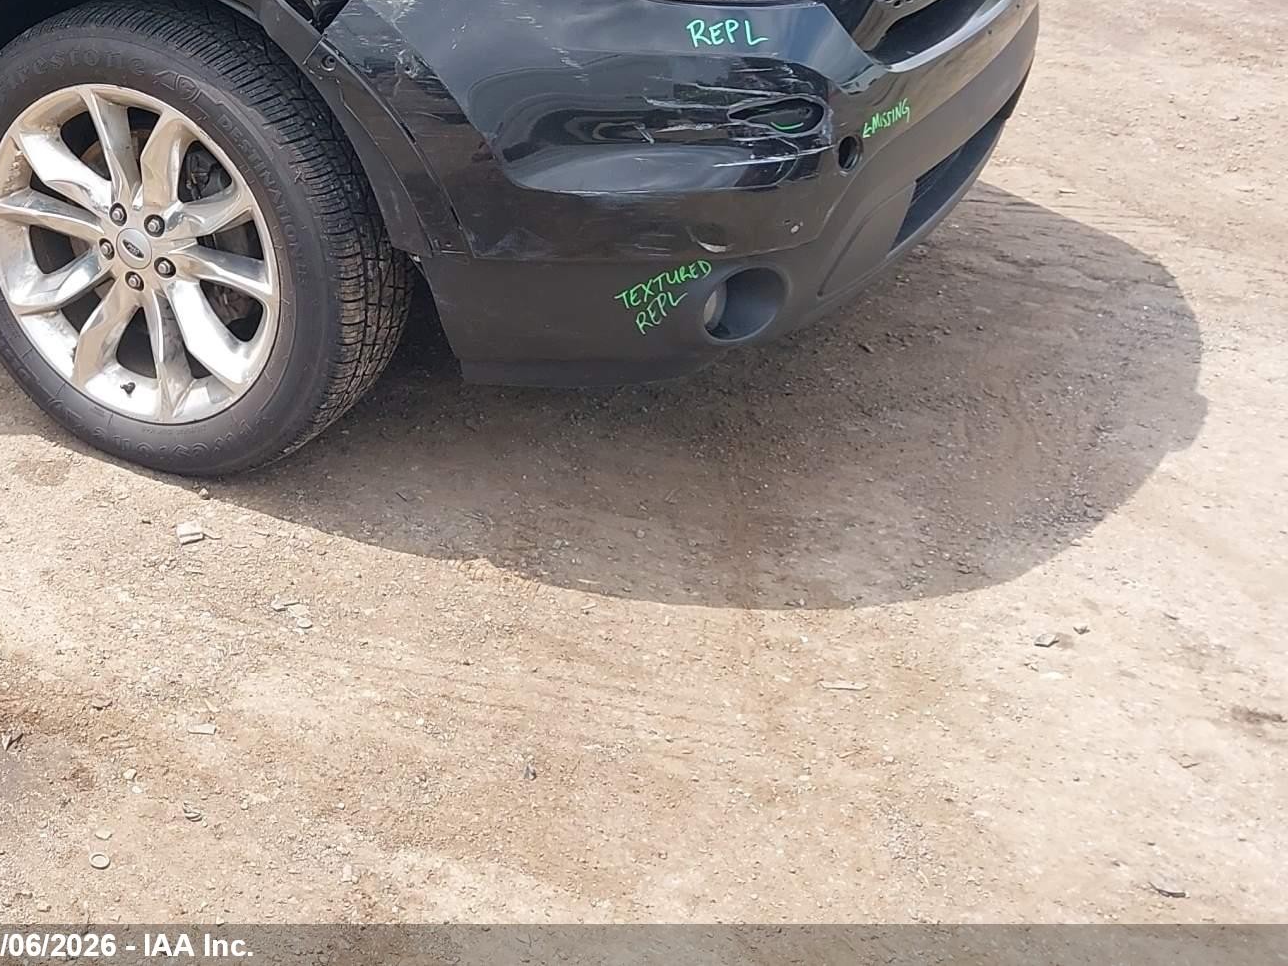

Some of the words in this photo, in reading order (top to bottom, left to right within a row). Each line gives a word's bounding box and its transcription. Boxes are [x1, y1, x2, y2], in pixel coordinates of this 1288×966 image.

[686, 19, 768, 48] REPL
[872, 97, 910, 134] MISSING
[614, 259, 712, 309] TEXTURED
[635, 291, 688, 335] REPL
